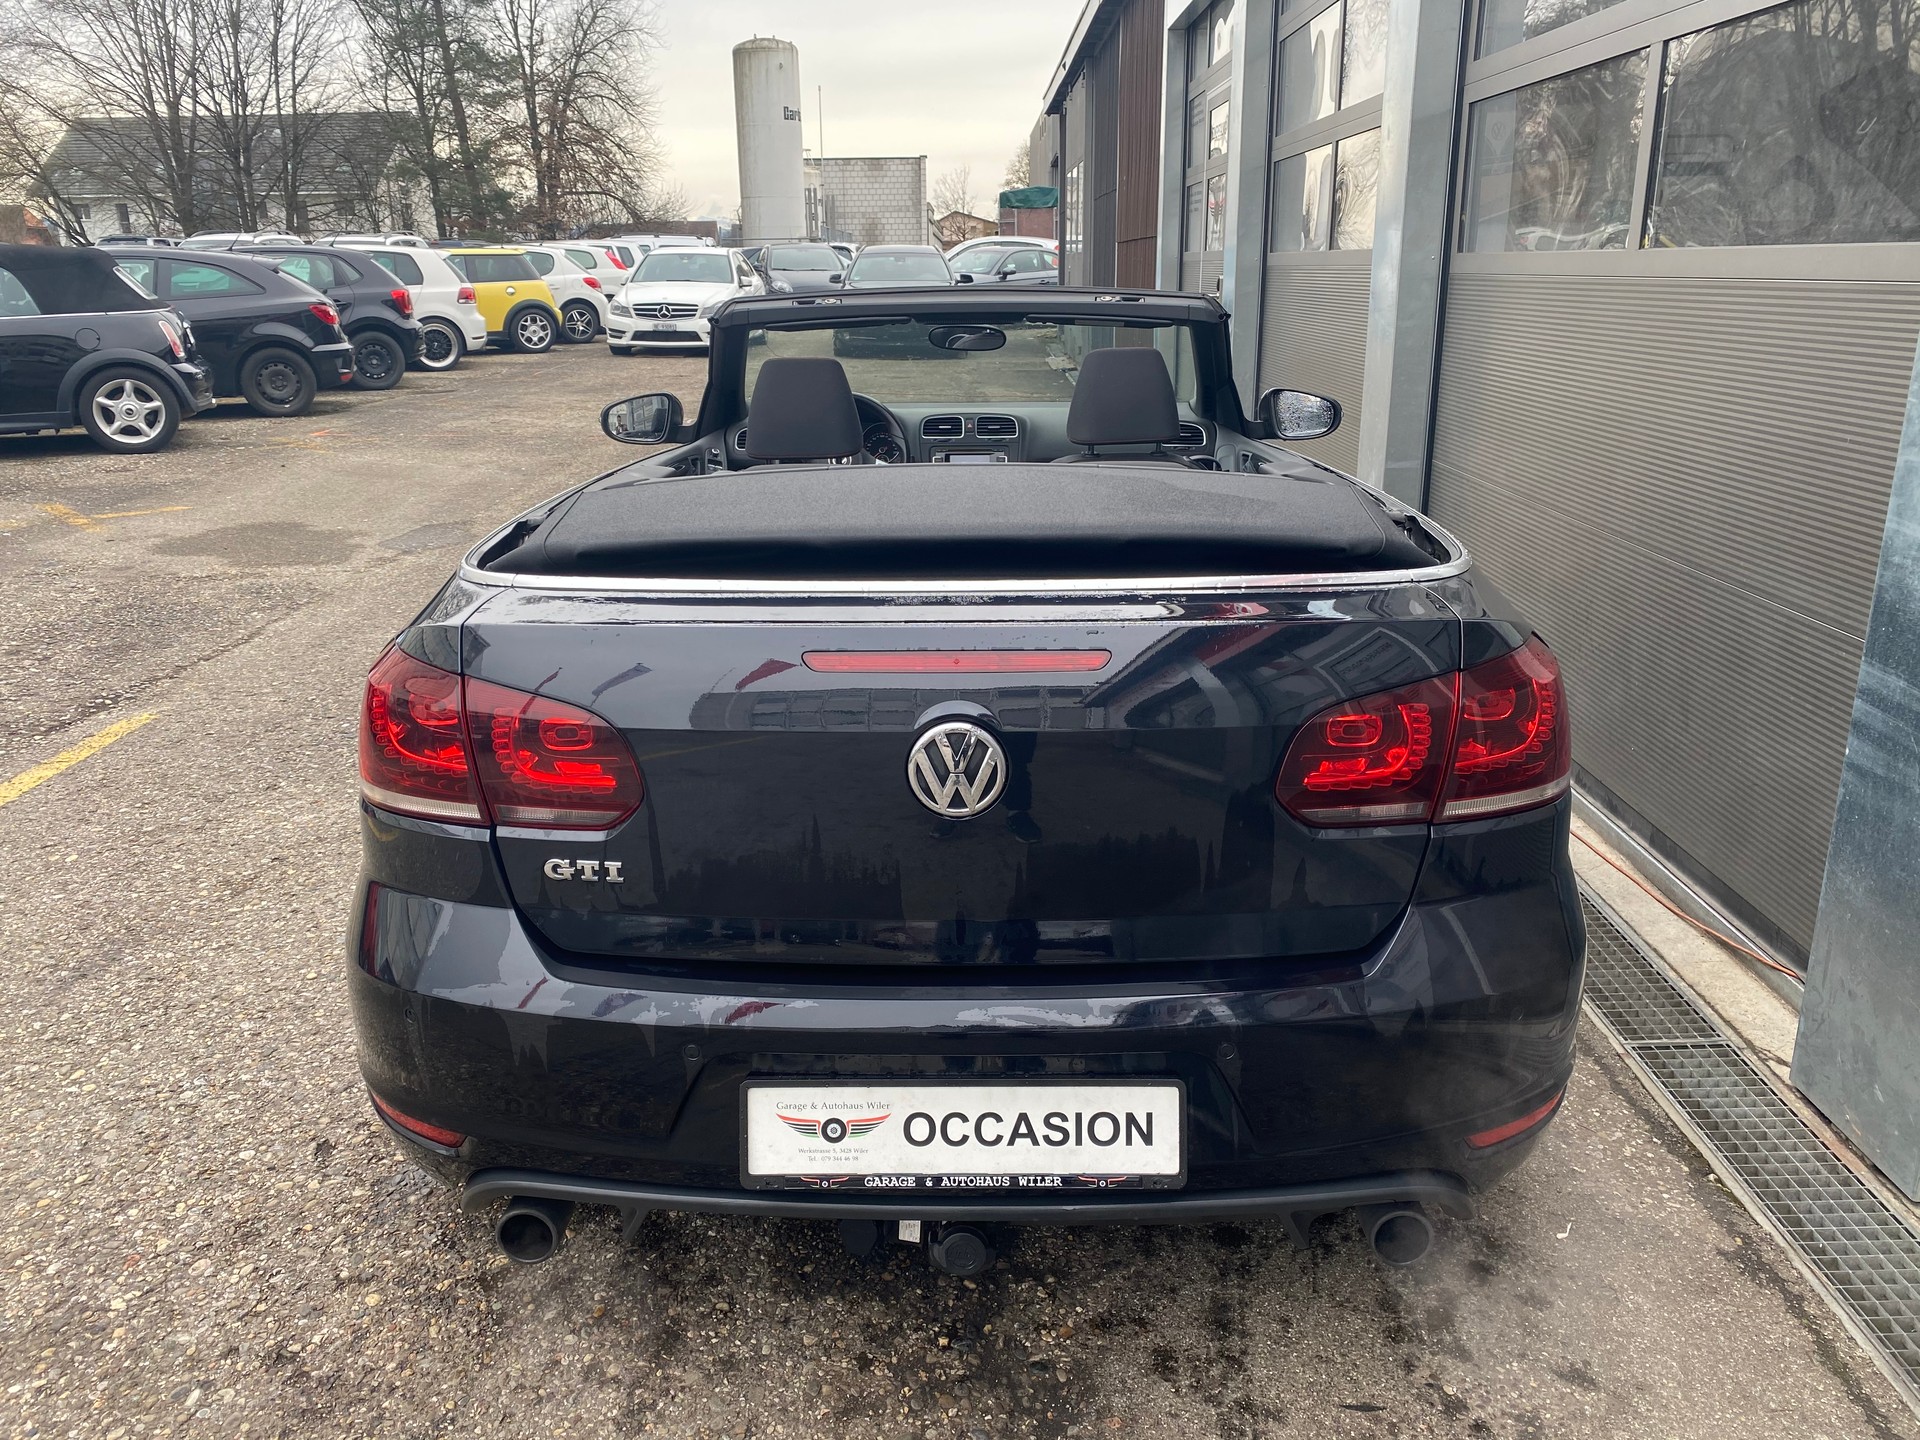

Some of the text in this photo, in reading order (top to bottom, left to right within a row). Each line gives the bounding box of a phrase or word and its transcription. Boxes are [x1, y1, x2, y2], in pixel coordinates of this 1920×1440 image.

[543, 858, 624, 883] GTI
[776, 1101, 890, 1112] Garage & Autohaus Wiler
[902, 1111, 1154, 1147] OCCASION
[864, 1176, 1063, 1187] GARAGE & AUTOHAUS WILER
